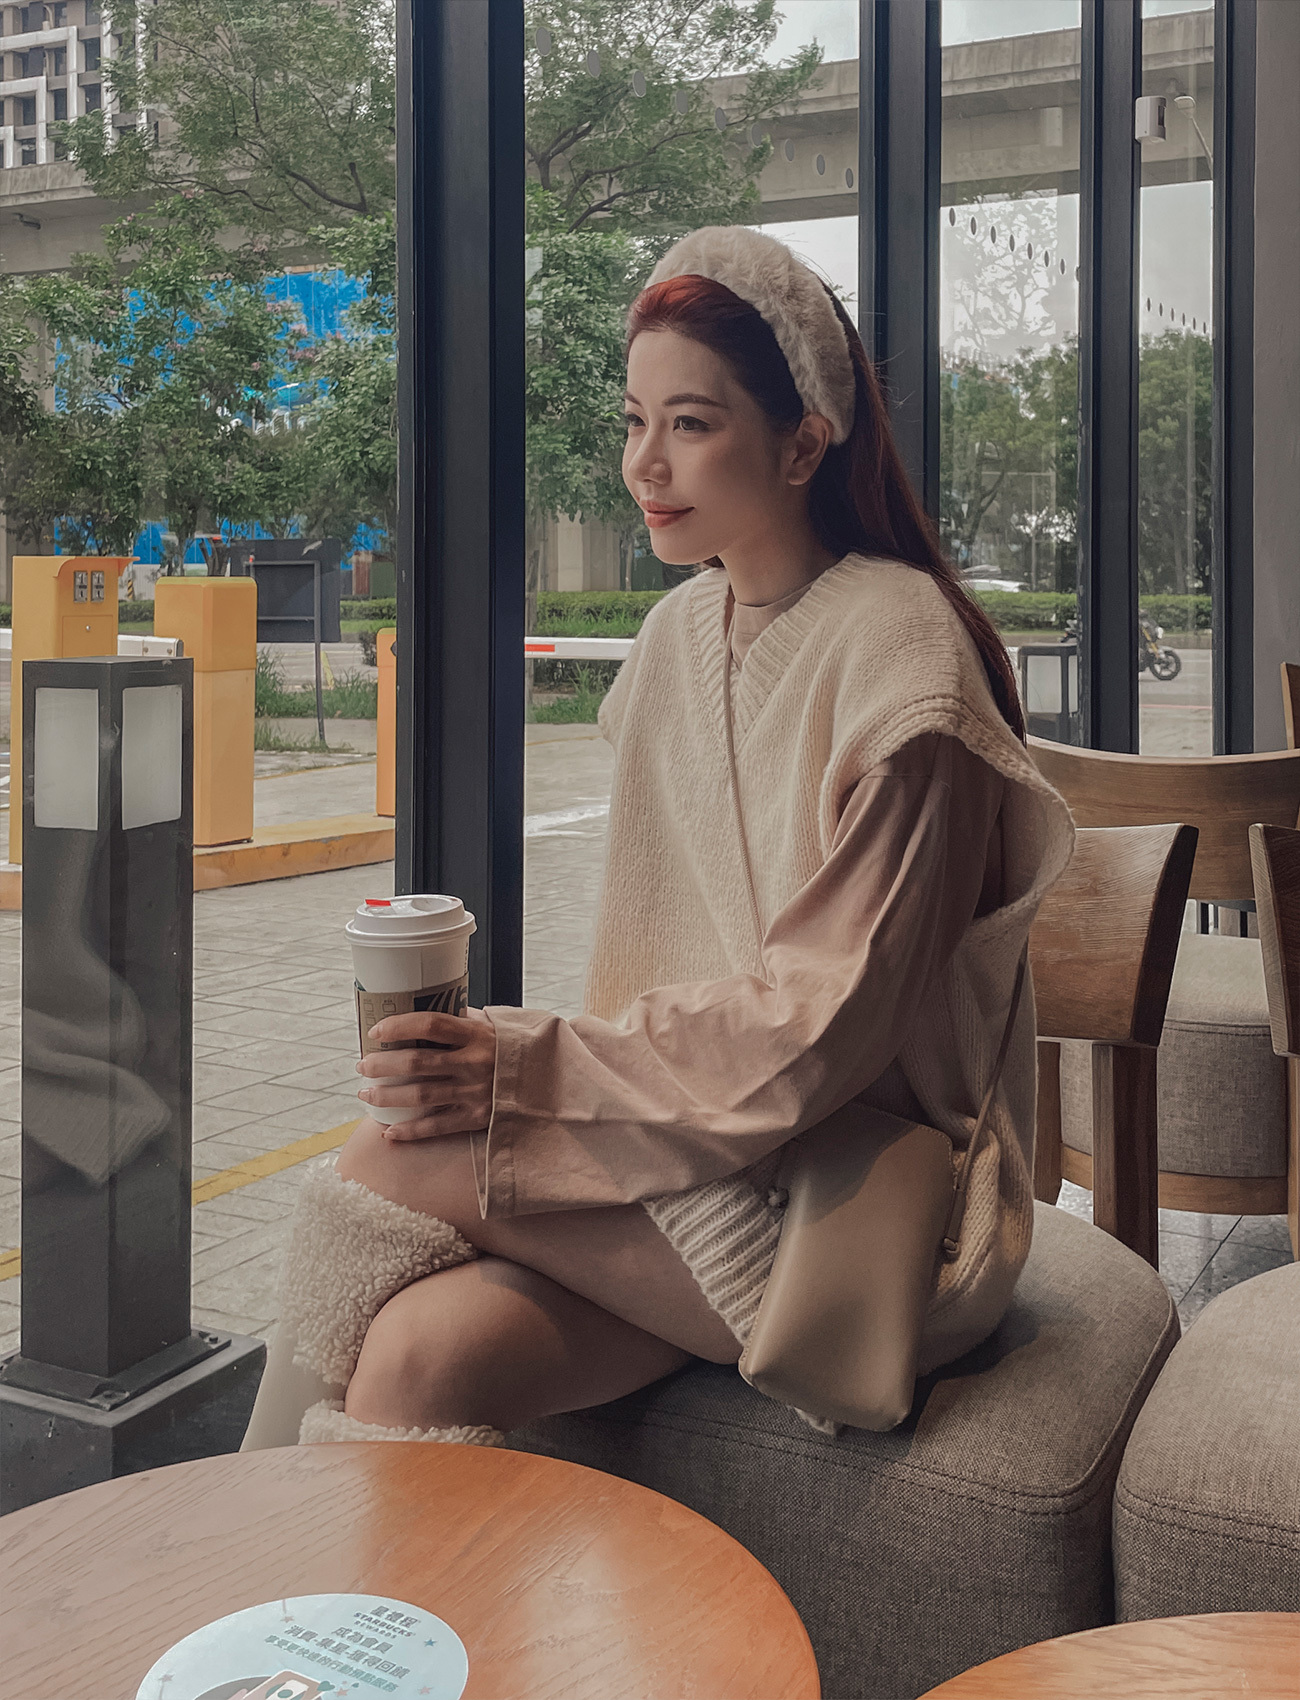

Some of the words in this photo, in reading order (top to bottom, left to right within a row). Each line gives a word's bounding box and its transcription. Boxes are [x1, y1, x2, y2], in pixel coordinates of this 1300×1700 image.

[354, 1612, 413, 1637] STARBUCKS
[354, 1620, 397, 1639] REWARDS
[331, 1626, 393, 1654] 成為會員
